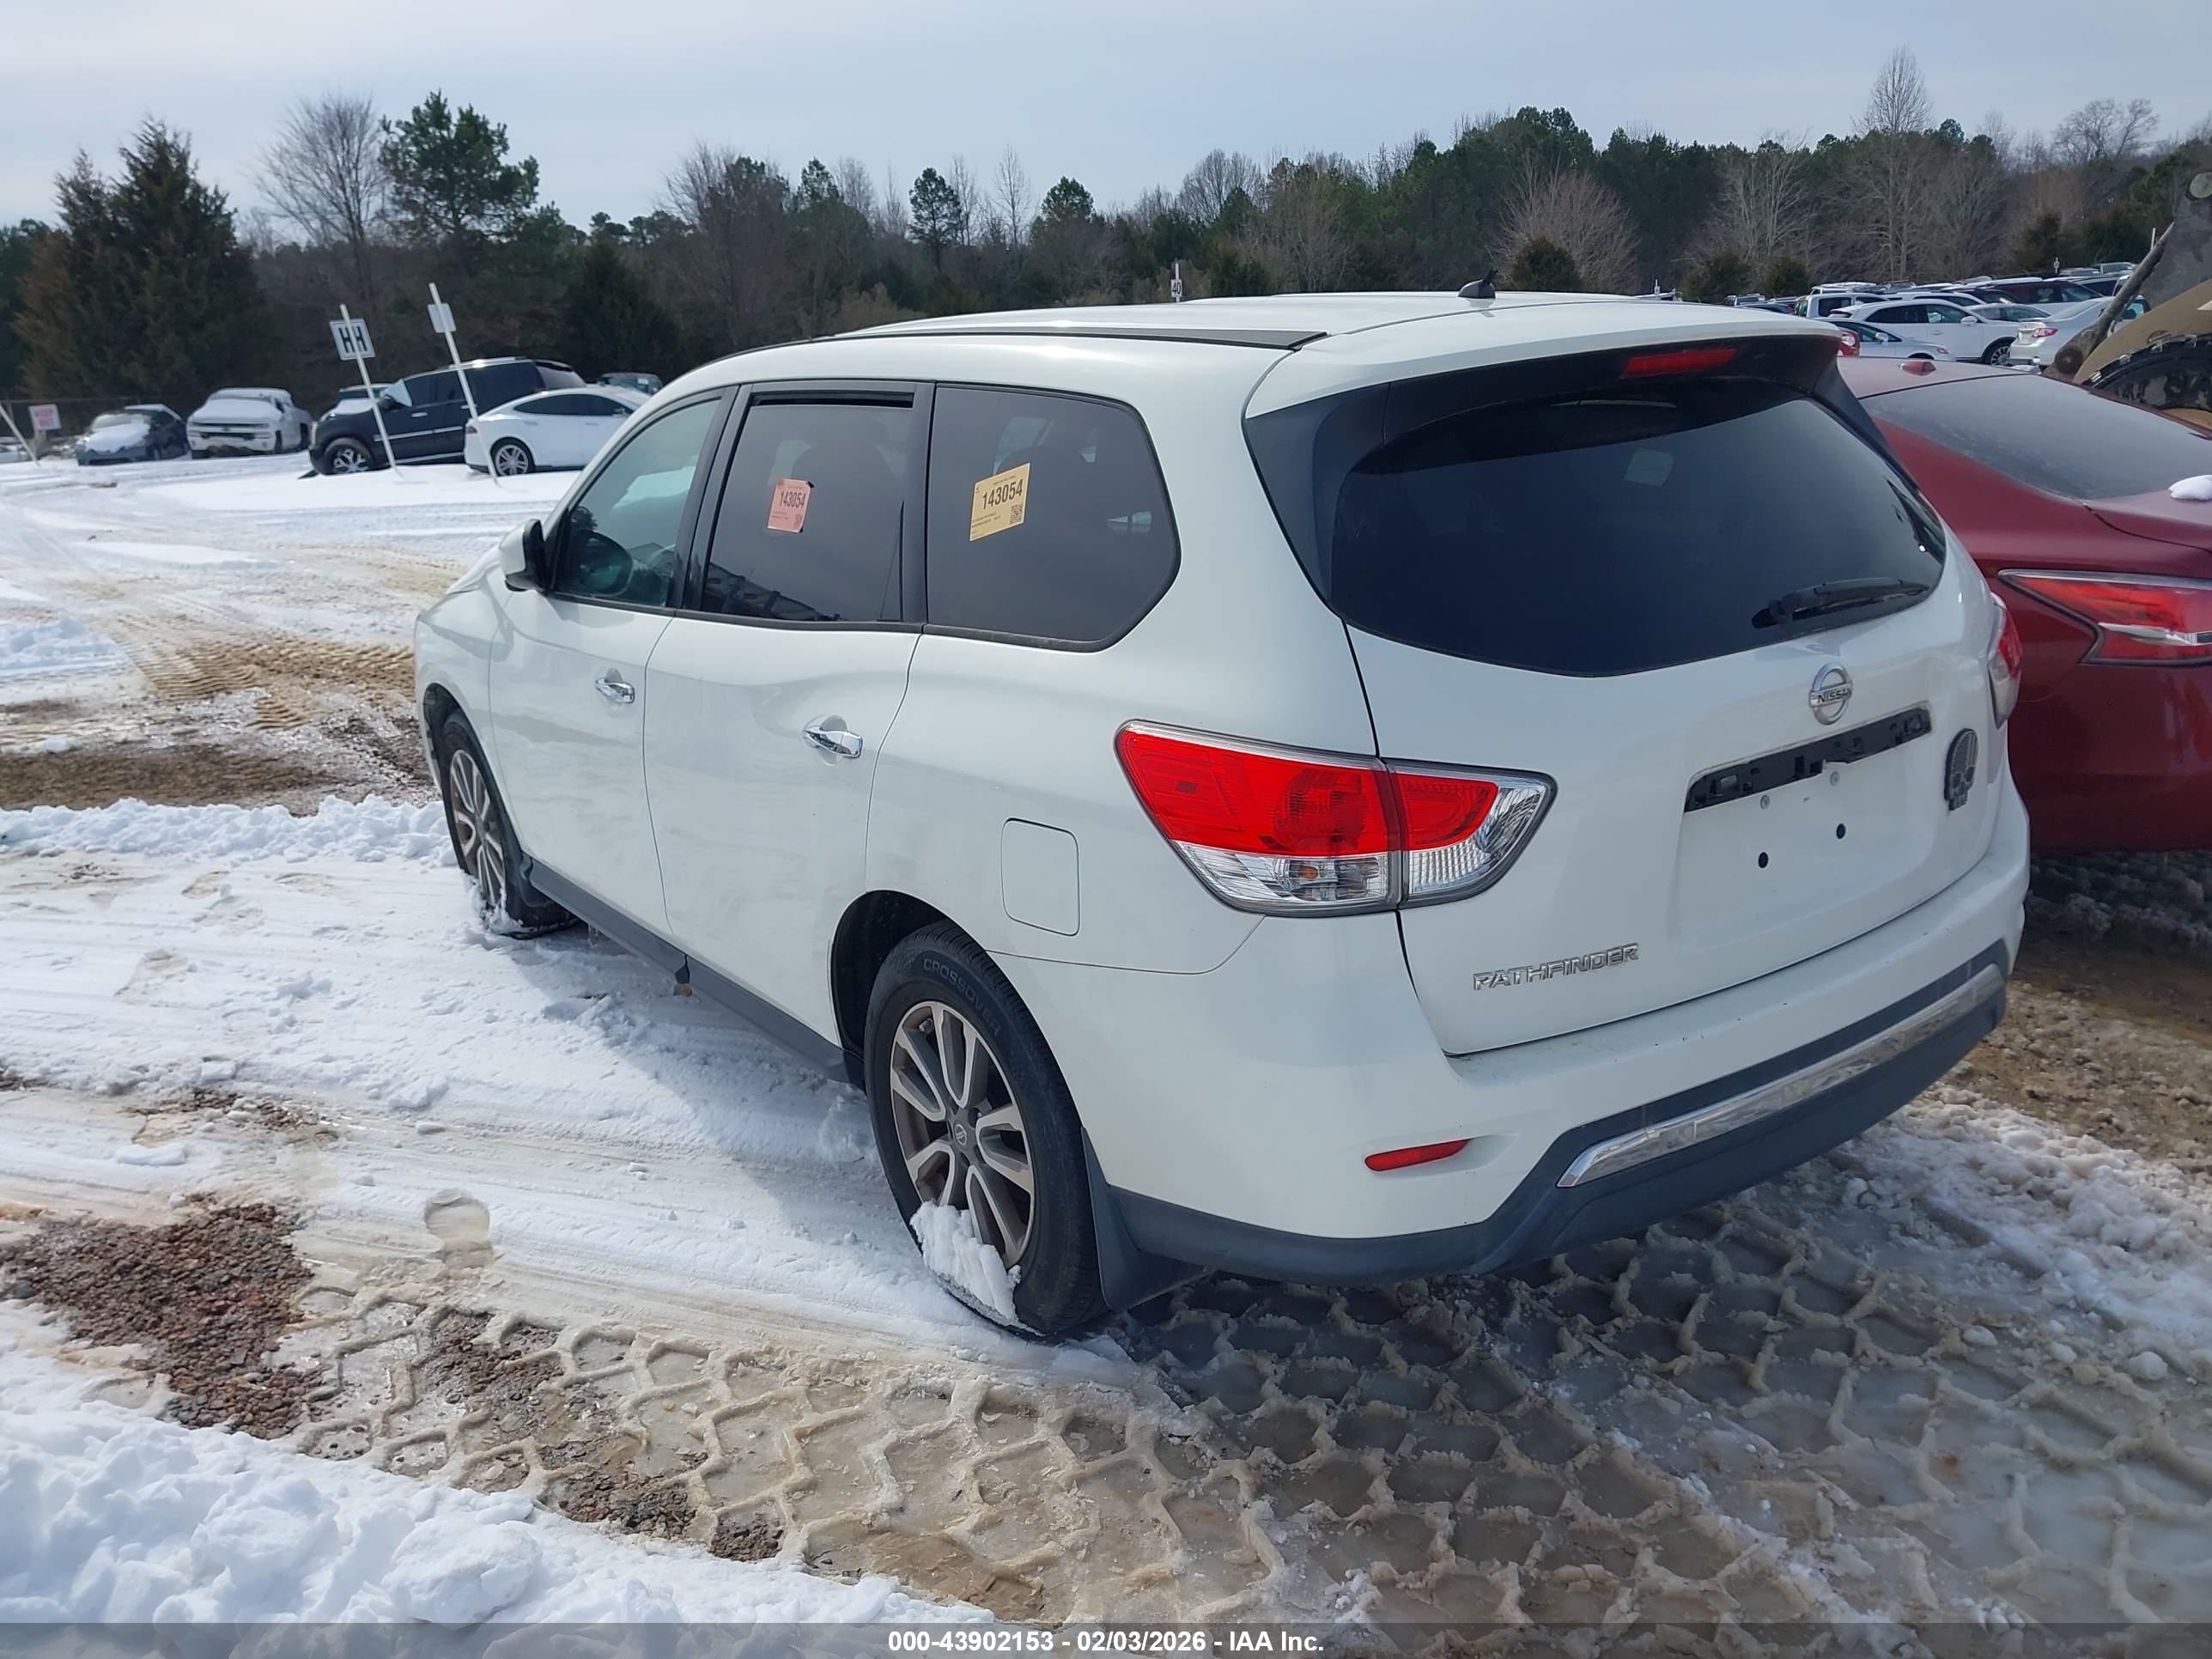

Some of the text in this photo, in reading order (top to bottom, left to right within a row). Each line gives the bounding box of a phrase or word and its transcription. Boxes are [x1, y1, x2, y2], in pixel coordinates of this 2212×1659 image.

[1172, 282, 1181, 295] 40
[338, 326, 368, 353] HH
[779, 490, 806, 509] 143054
[982, 478, 1024, 510] 143054
[1473, 942, 1639, 990] PATHFINDER
[923, 957, 1001, 1036] CROSSOVER
